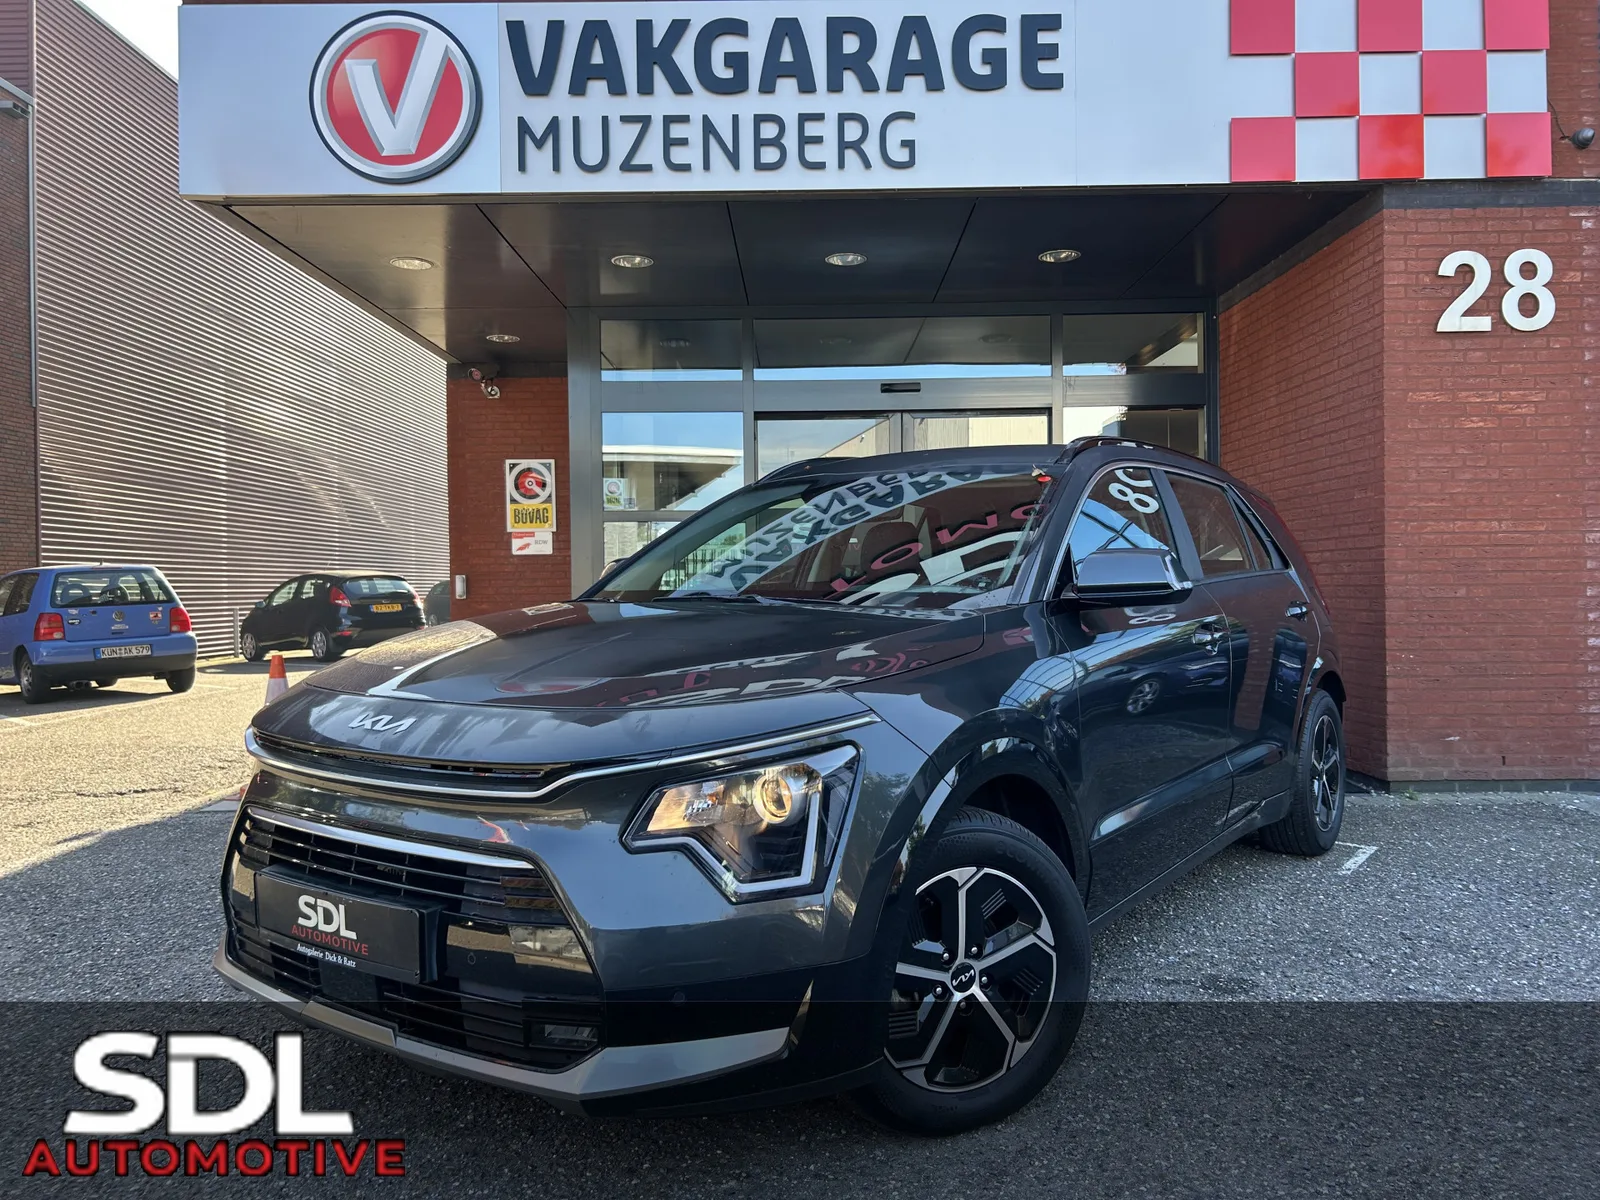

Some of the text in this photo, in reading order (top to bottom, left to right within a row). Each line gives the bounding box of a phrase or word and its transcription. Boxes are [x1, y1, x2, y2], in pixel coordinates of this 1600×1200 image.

[505, 14, 1064, 97] VAKGARAGE
[345, 28, 452, 156] V
[516, 111, 917, 173] MUZENBERG
[1437, 248, 1556, 332] 28
[514, 507, 549, 524] BOVAG
[124, 646, 134, 655] AK
[135, 645, 150, 655] 579
[348, 713, 417, 735] KIA
[297, 894, 358, 940] SDL
[291, 925, 369, 955] AUTOMOTIVE
[325, 951, 337, 962] Dick
[337, 955, 343, 964] &
